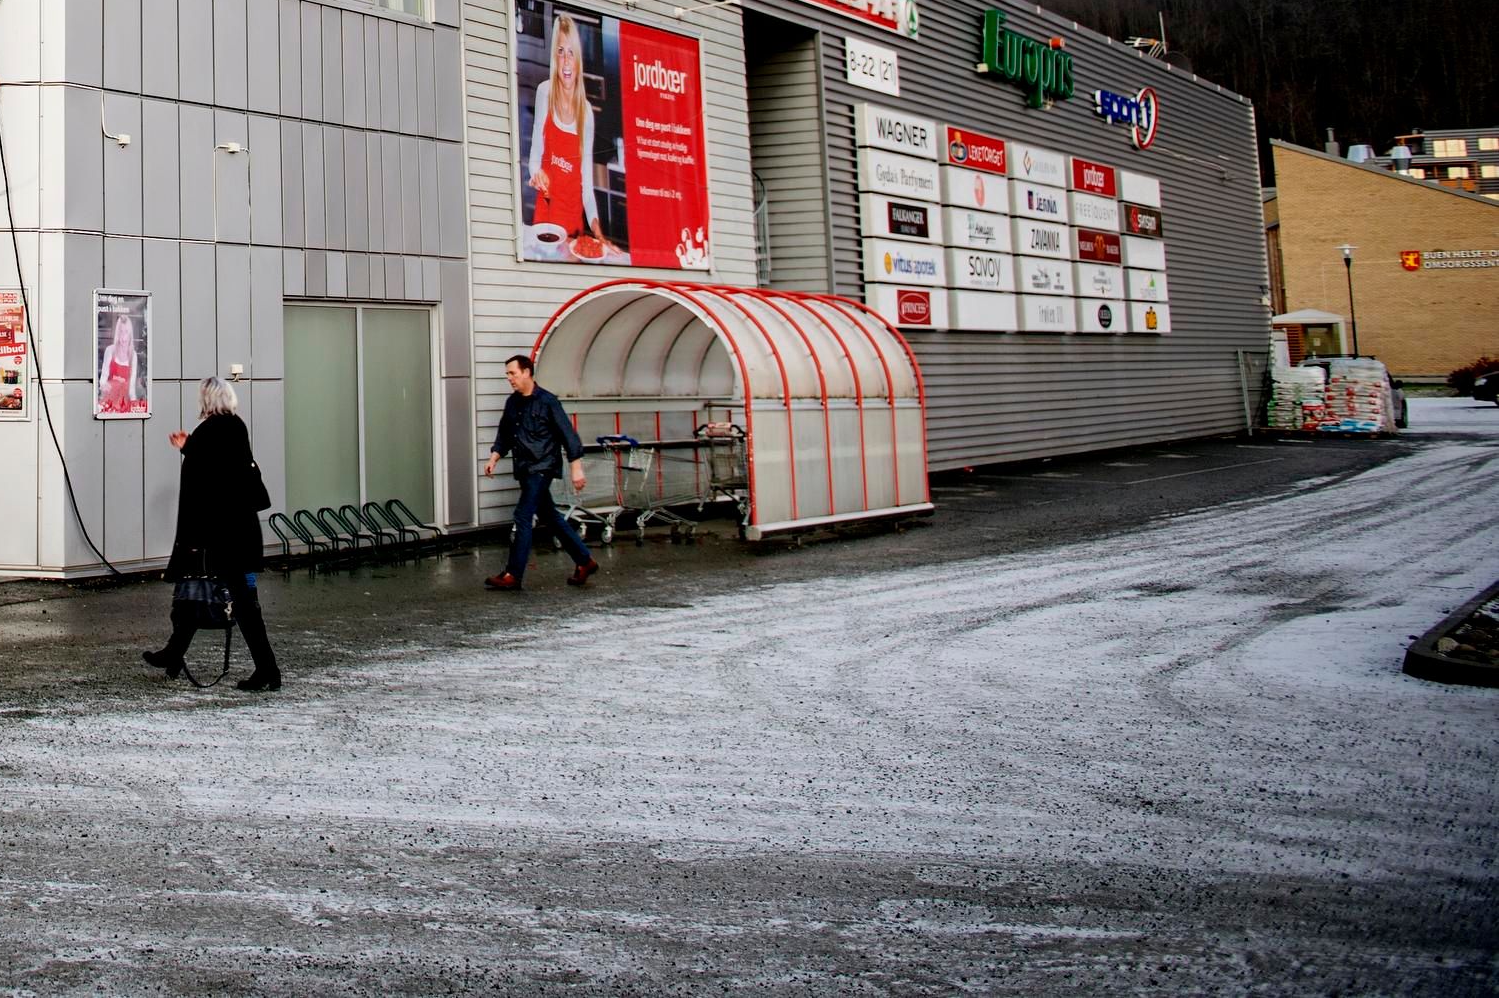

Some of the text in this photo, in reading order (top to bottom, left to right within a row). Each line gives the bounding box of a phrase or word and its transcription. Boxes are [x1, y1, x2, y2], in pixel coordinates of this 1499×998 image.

[984, 10, 1075, 108] Europris
[633, 55, 687, 94] jordbær
[876, 116, 928, 149] WAGNER
[968, 145, 1004, 166] LEKETORGET
[892, 207, 924, 225] FALKANGER
[1031, 229, 1061, 252] ZAVANNA
